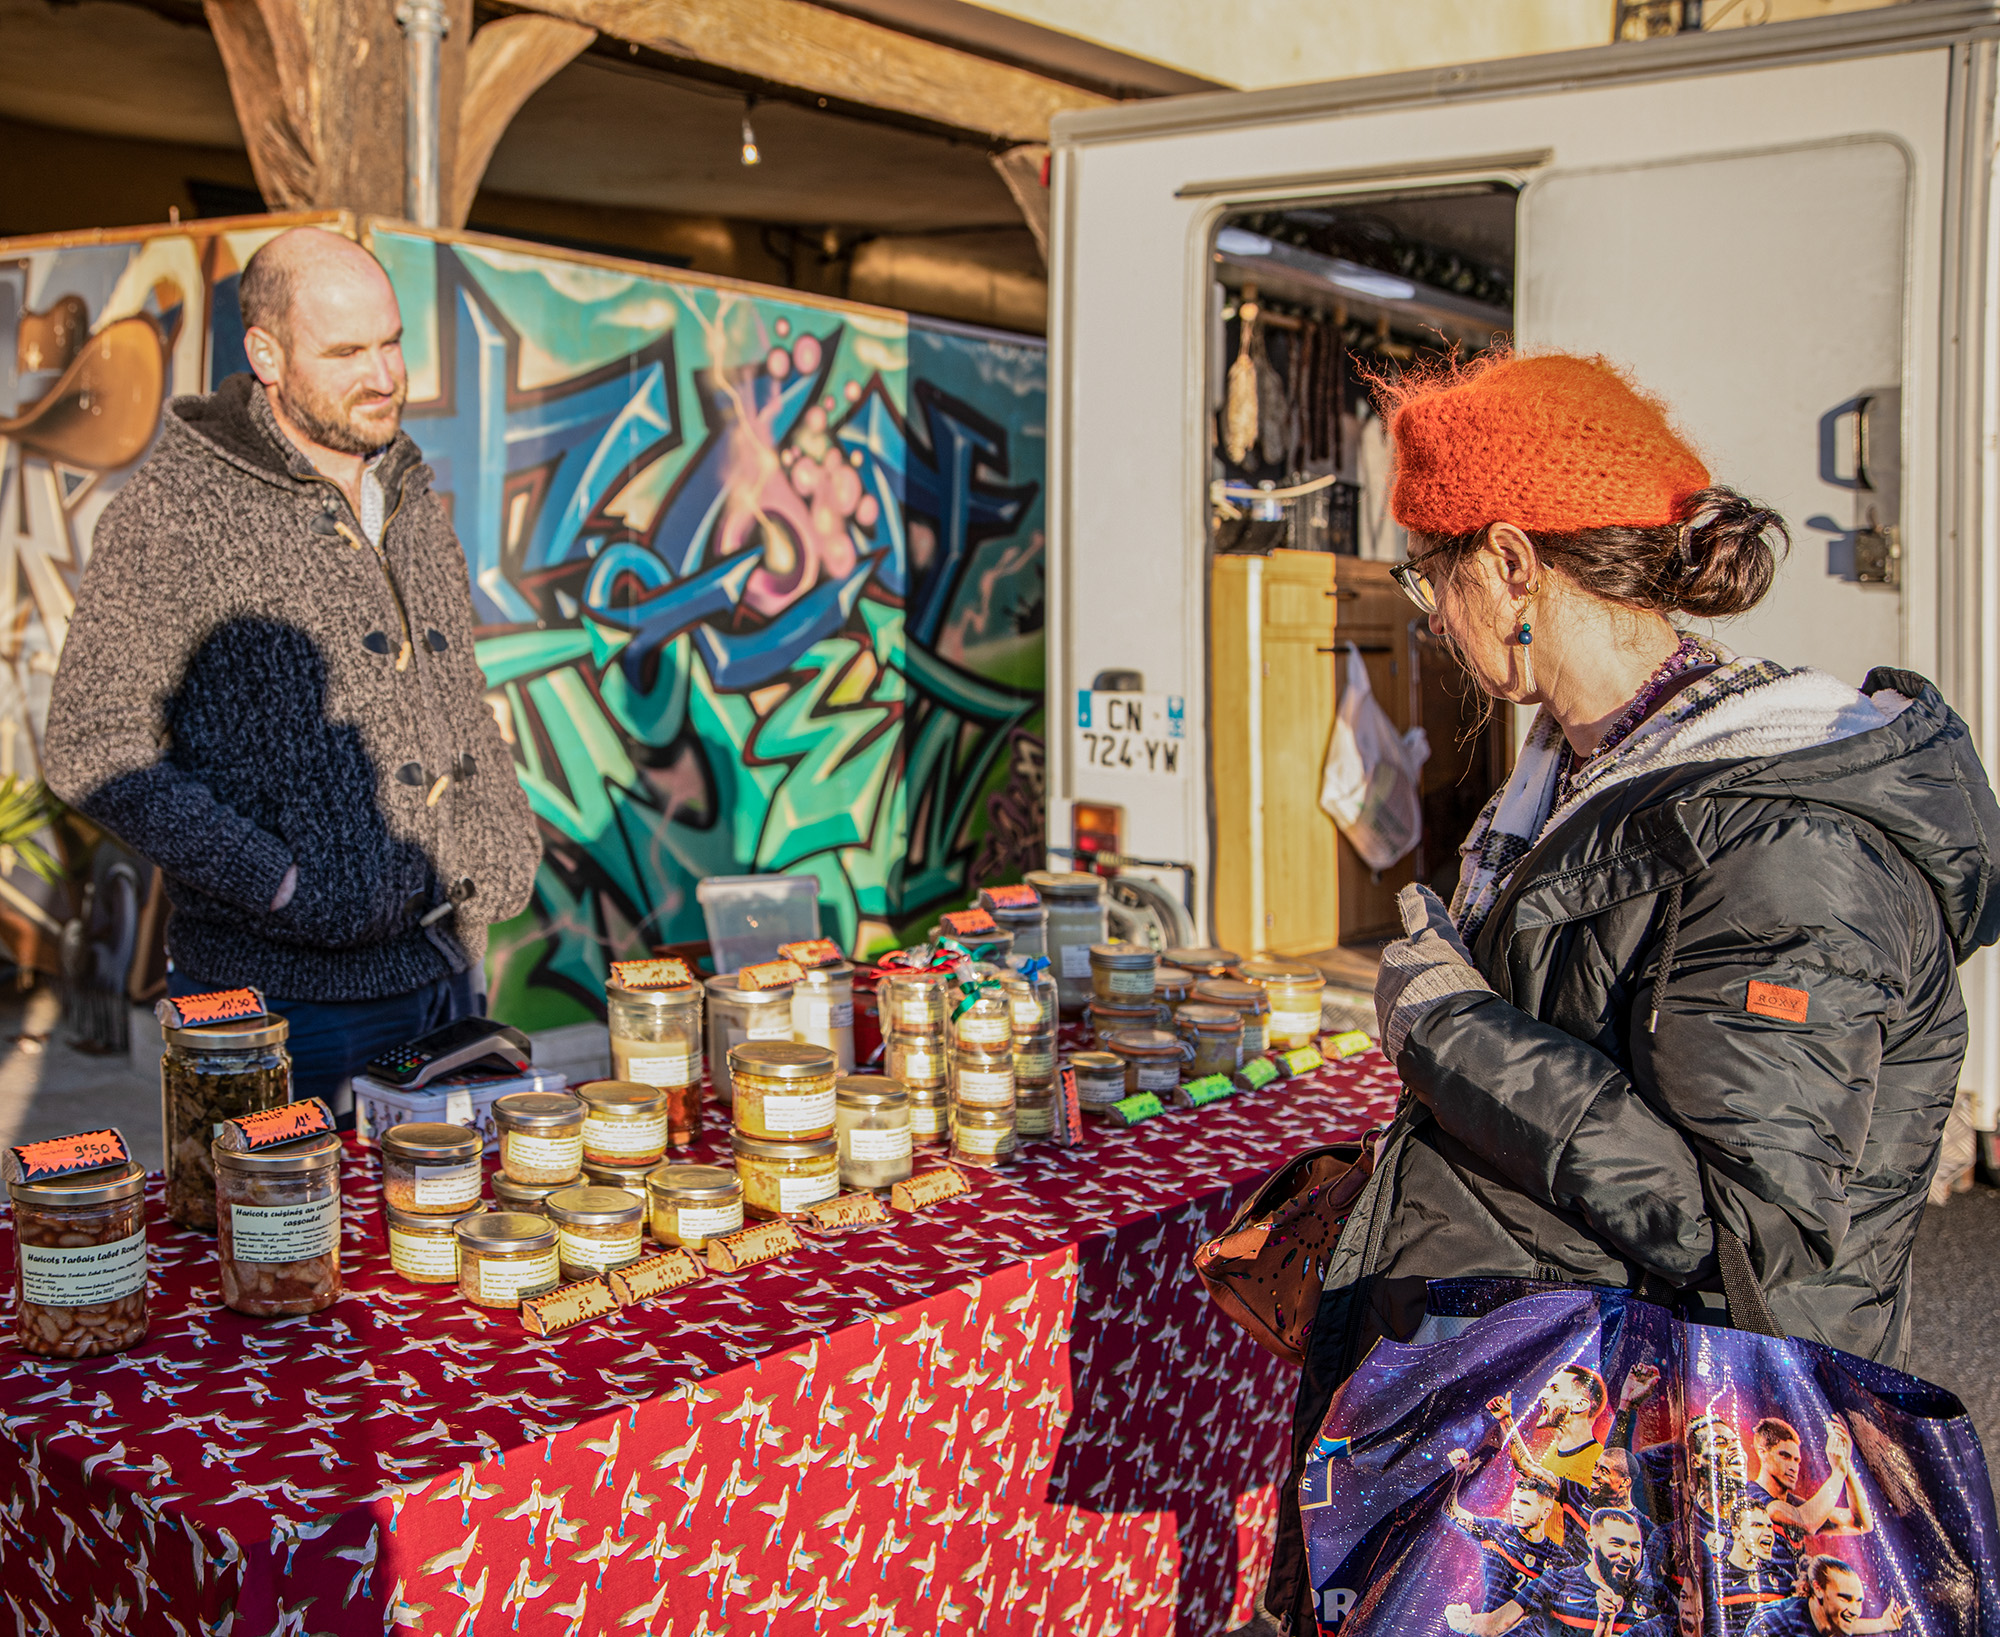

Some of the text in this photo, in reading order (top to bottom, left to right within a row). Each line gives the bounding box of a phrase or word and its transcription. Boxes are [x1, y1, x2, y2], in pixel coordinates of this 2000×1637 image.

[1758, 994, 1798, 1009] ROXY
[236, 1208, 269, 1218] Haricots
[270, 1207, 303, 1218] cuisinés
[283, 1213, 321, 1227] cassoulet
[28, 1253, 60, 1265] Haricots
[62, 1255, 96, 1264] Tarbais
[97, 1249, 120, 1261] Label
